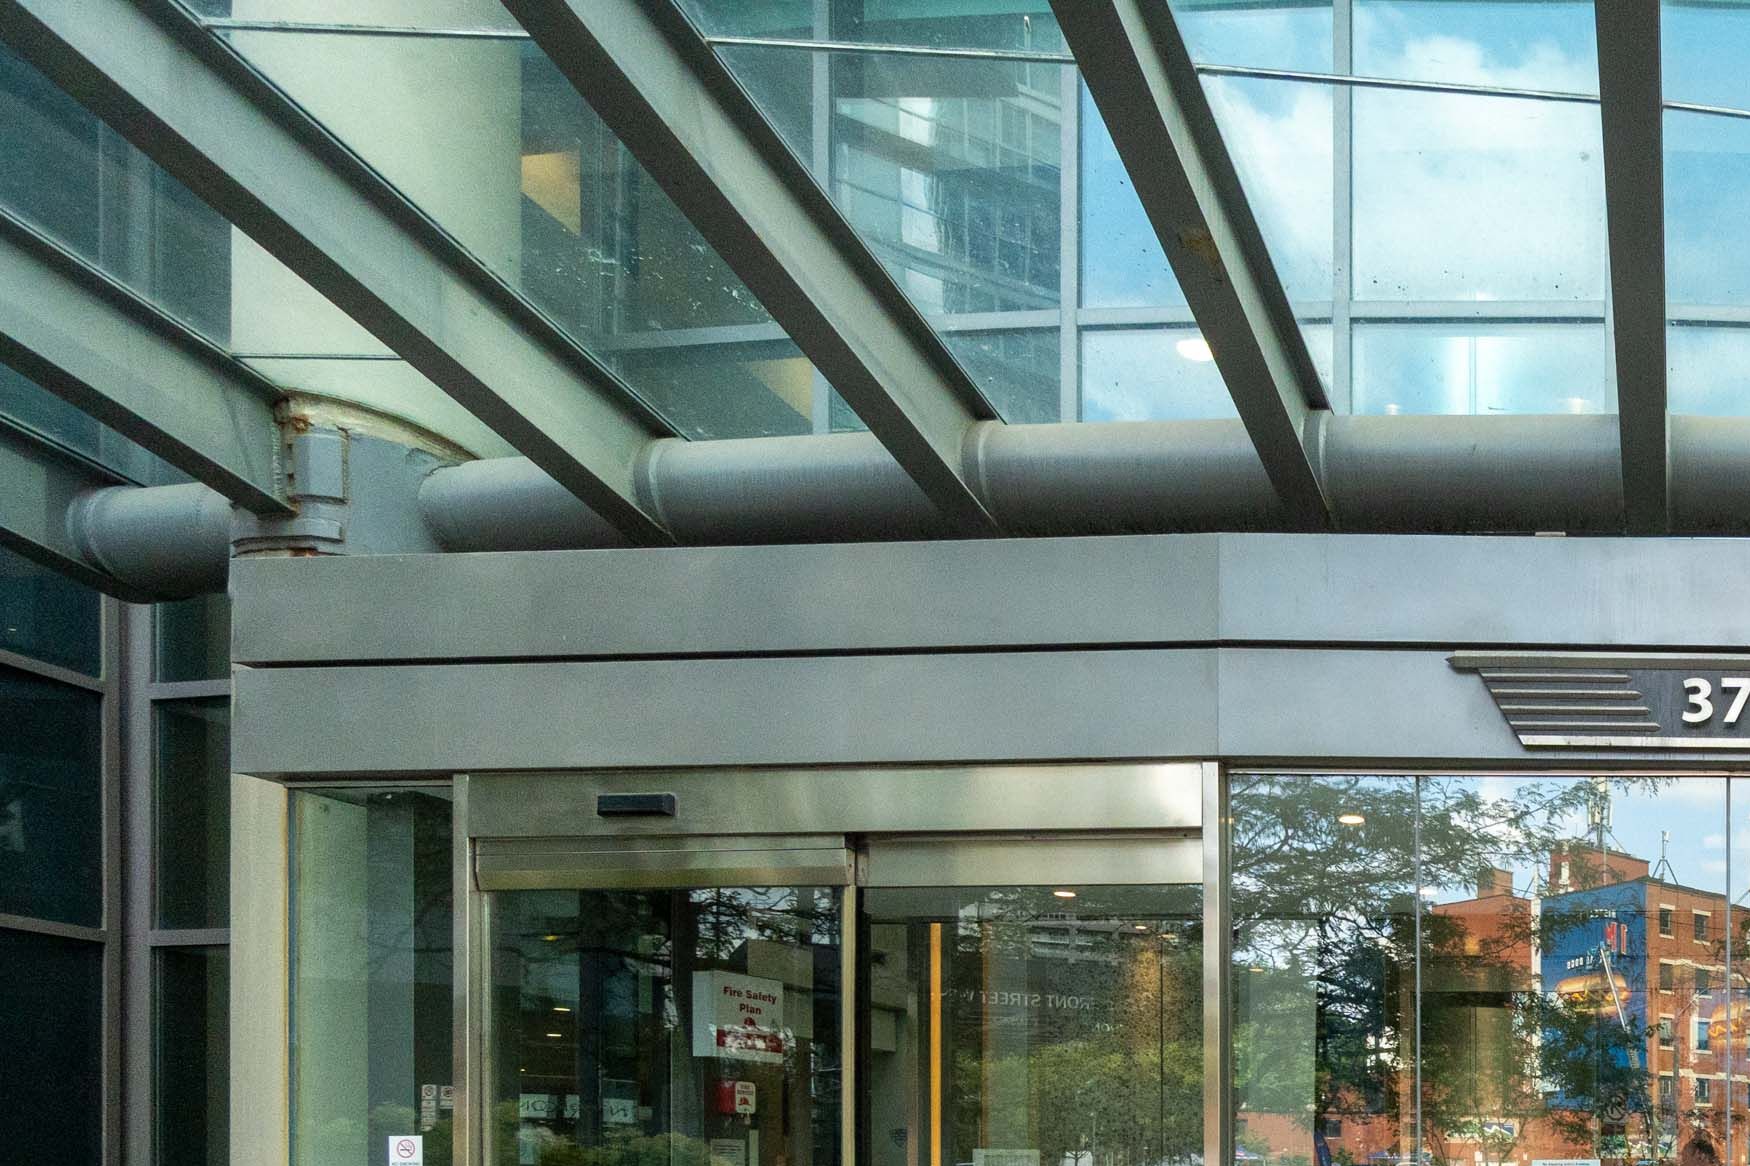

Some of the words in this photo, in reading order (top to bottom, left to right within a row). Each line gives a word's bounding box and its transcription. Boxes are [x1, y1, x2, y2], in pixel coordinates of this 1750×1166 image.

[723, 986, 743, 998] Fire
[745, 989, 777, 1005] Safety
[739, 1003, 762, 1015] Plan
